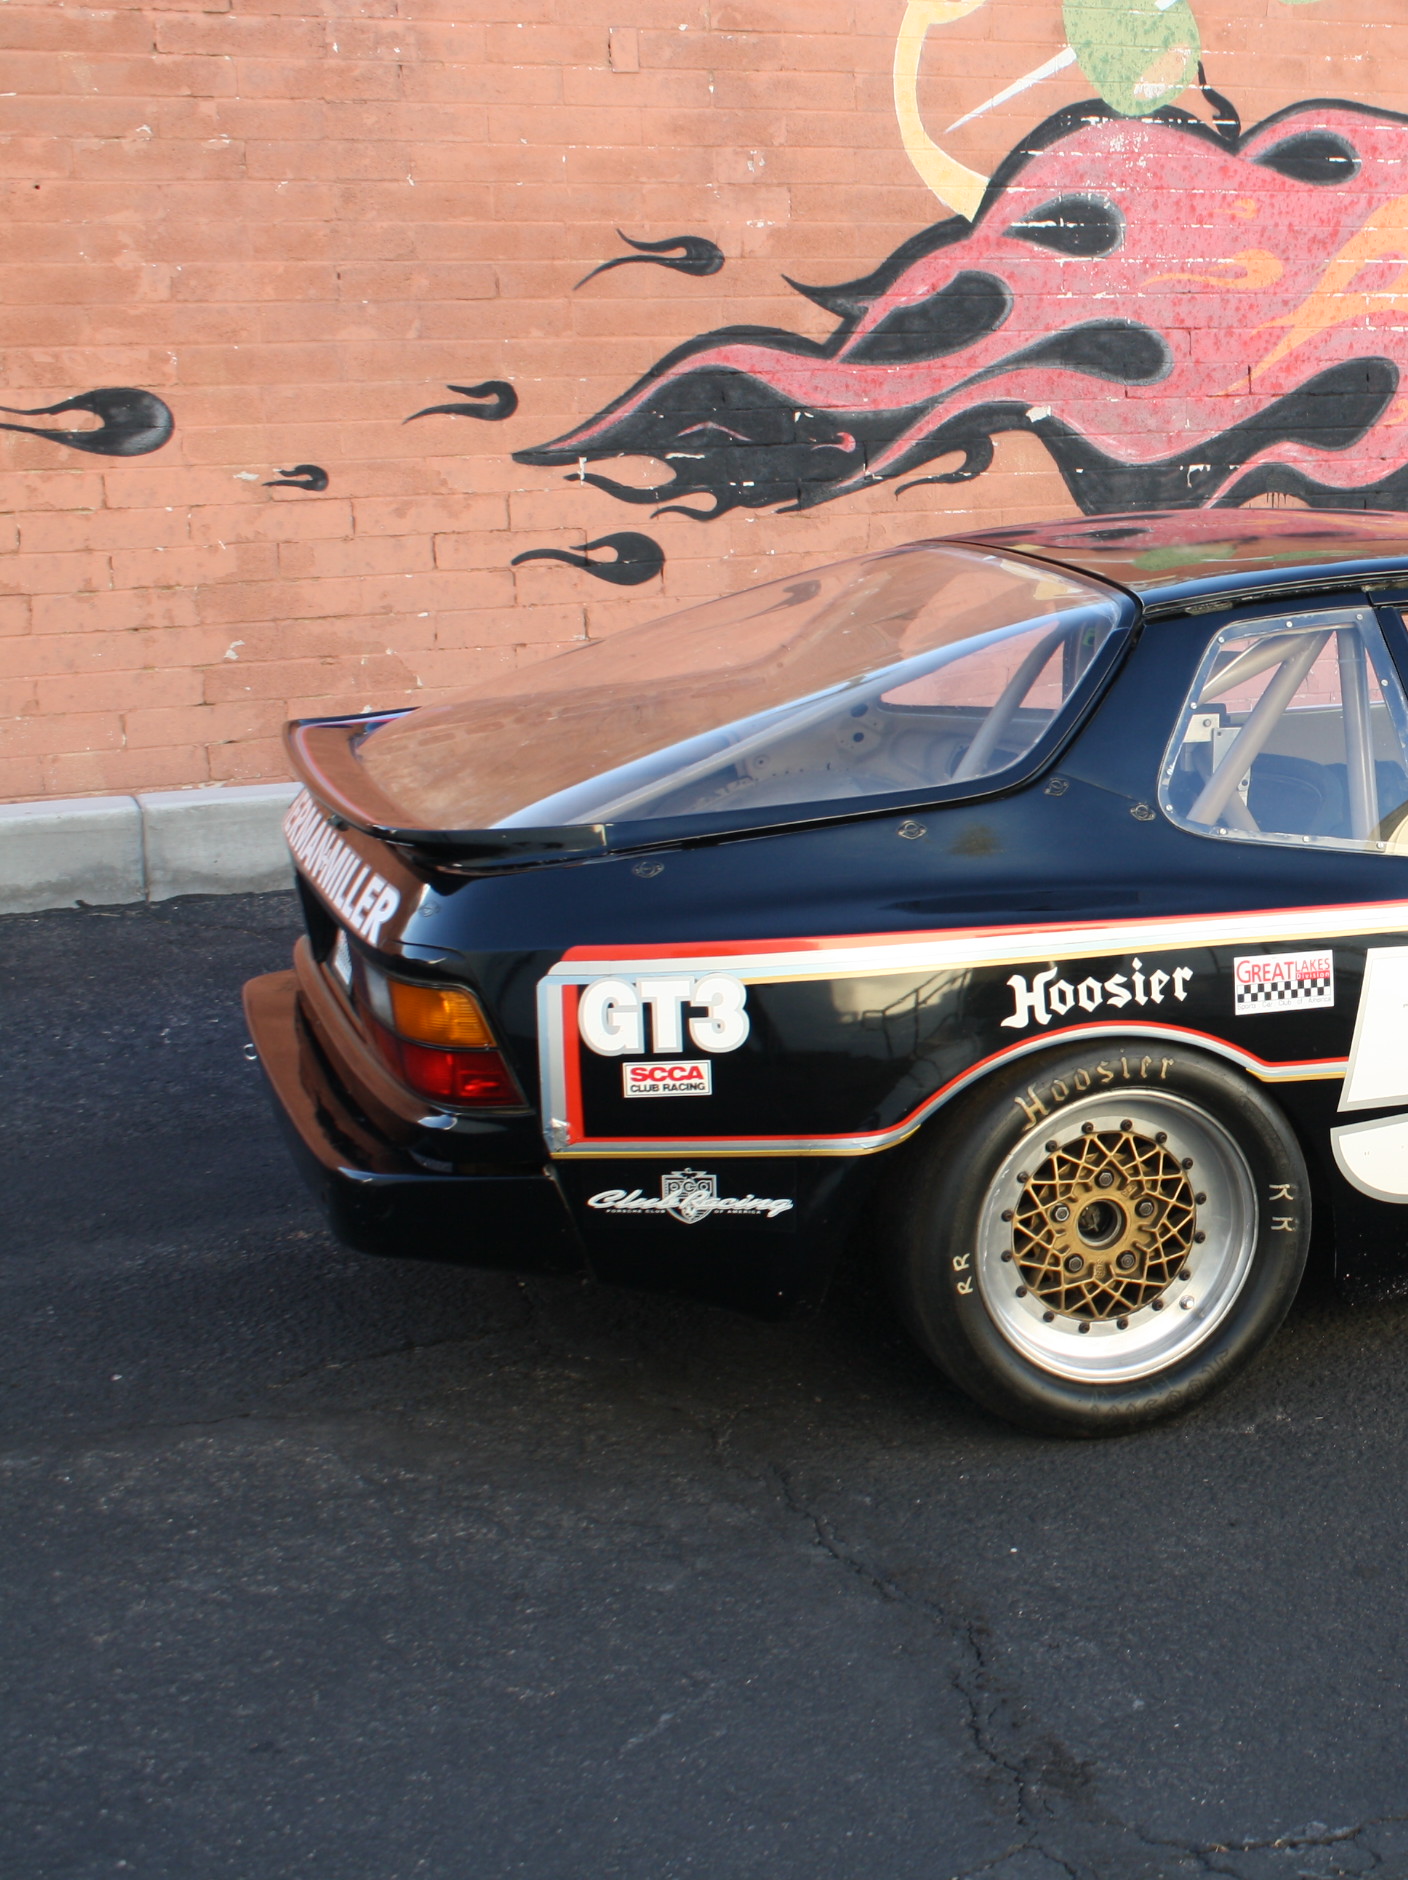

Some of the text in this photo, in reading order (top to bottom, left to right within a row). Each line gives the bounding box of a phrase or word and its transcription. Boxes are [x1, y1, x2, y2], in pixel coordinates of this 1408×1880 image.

[1236, 957, 1331, 984] GREAT LAKES
[1296, 970, 1331, 981] Division
[1000, 956, 1194, 1029] Hoosier
[577, 971, 751, 1057] GT3
[630, 1065, 705, 1082] SCCA
[630, 1081, 706, 1093] CLUB RACING
[1014, 1048, 1175, 1132] Hoosier
[587, 1189, 794, 1218] Club Racing
